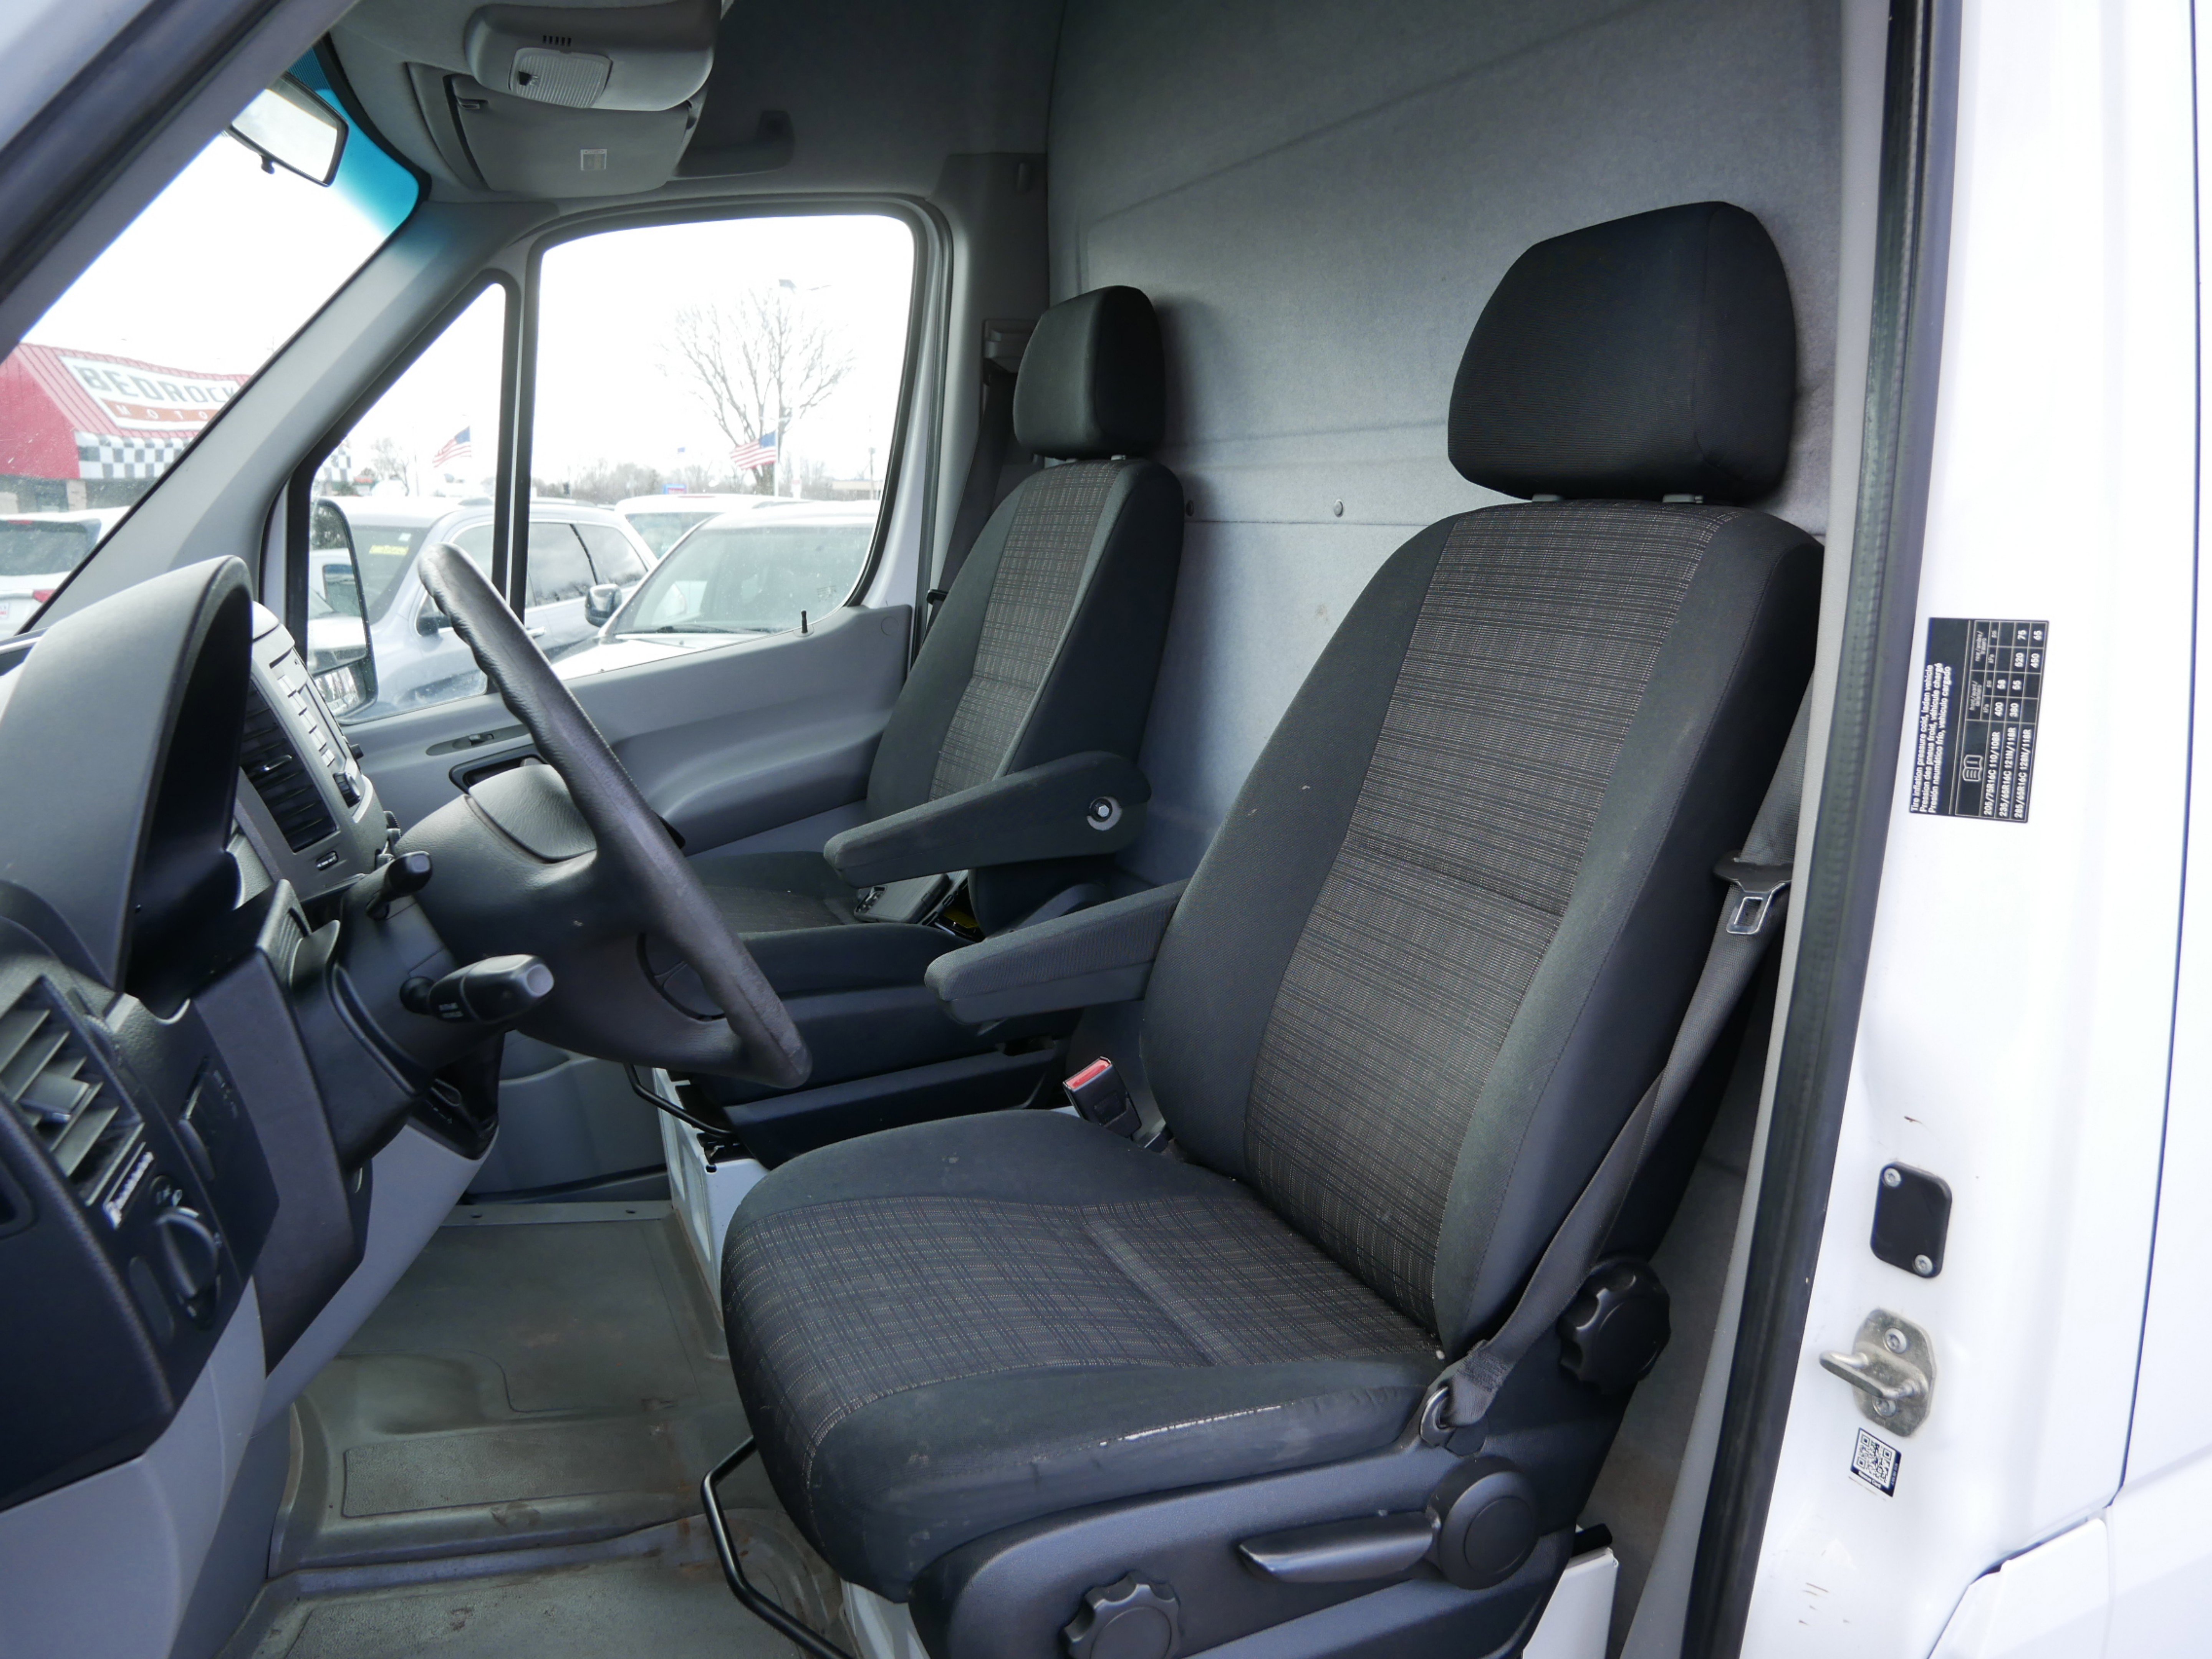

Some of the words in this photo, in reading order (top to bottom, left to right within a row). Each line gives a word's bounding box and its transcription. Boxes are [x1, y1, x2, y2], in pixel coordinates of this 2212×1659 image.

[73, 366, 237, 402] BEDROCK
[116, 404, 208, 420] MOTO
[2017, 630, 2027, 640] 75
[2015, 653, 2024, 667] 520
[2030, 653, 2040, 668] 450
[1924, 665, 1934, 691] vehicle
[1932, 663, 1943, 689] chargé
[1942, 666, 1952, 696] cargado
[1921, 692, 1931, 713] laden
[1995, 702, 2003, 717] 400
[2009, 703, 2019, 717] 380
[1920, 714, 1929, 732] cold,
[1917, 733, 1926, 765] pressure
[1926, 743, 1934, 765] pneus
[1912, 767, 1923, 796] inflation
[1924, 766, 1932, 780] des
[1911, 797, 1920, 811] Tire
[1919, 781, 1930, 812] Pression
